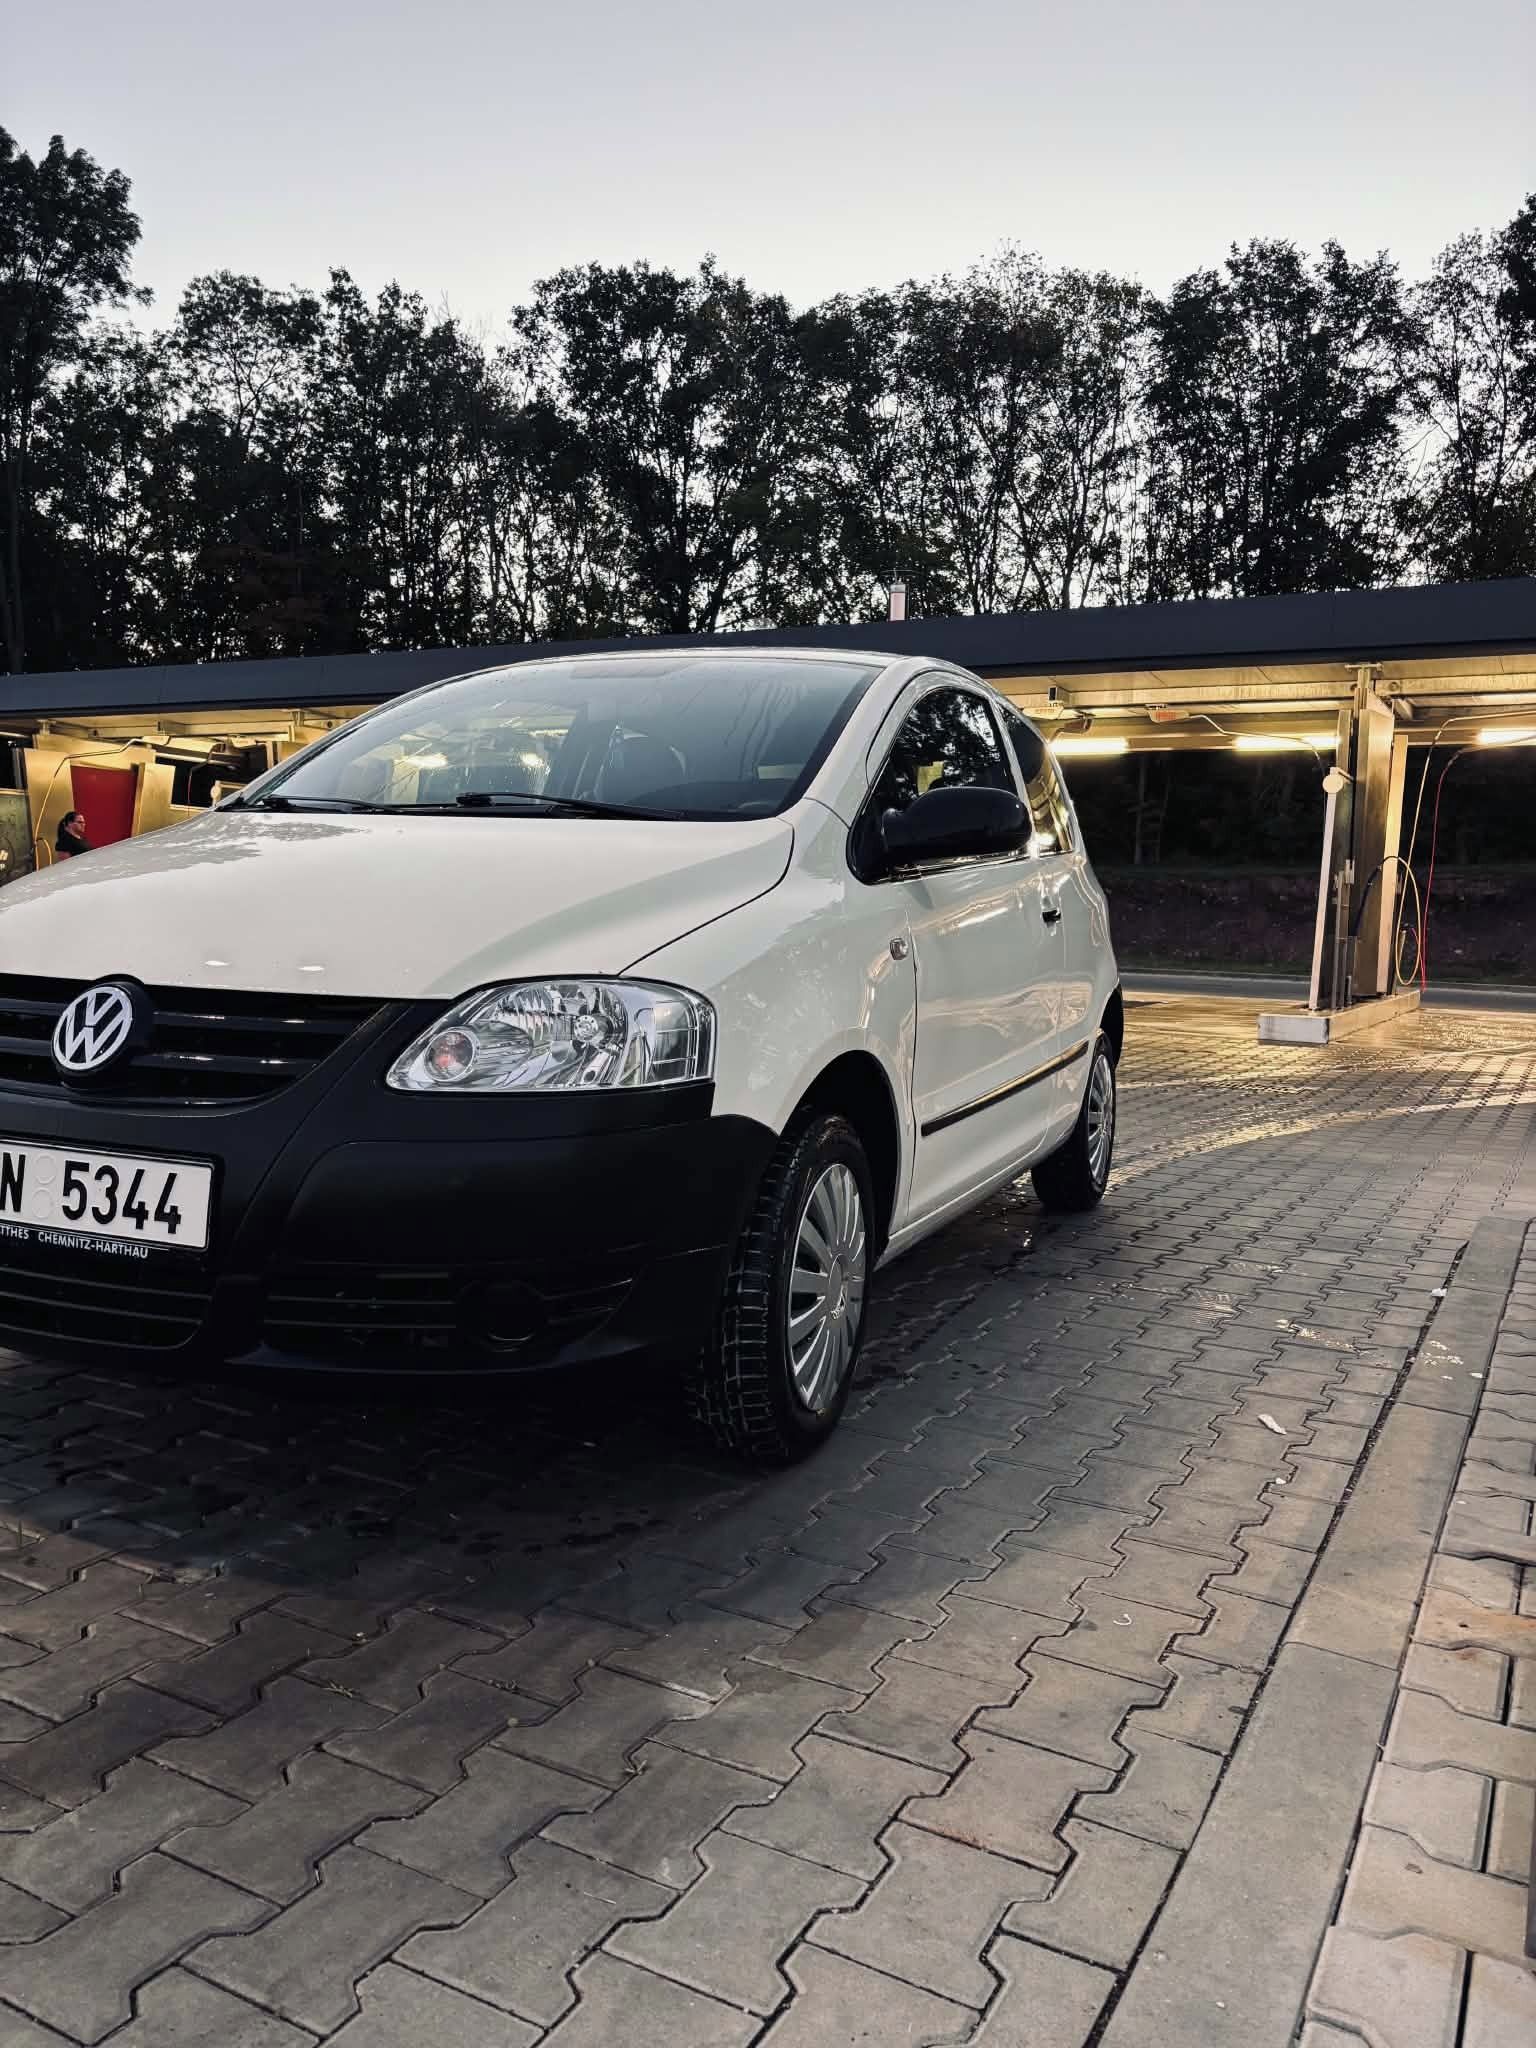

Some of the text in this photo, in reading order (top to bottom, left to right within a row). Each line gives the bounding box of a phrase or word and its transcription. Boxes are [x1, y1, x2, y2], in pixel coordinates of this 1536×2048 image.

[54, 986, 132, 1070] VW
[0, 1152, 181, 1234] N 5344
[38, 1231, 149, 1259] CHEMNITZ-HARTHAU
